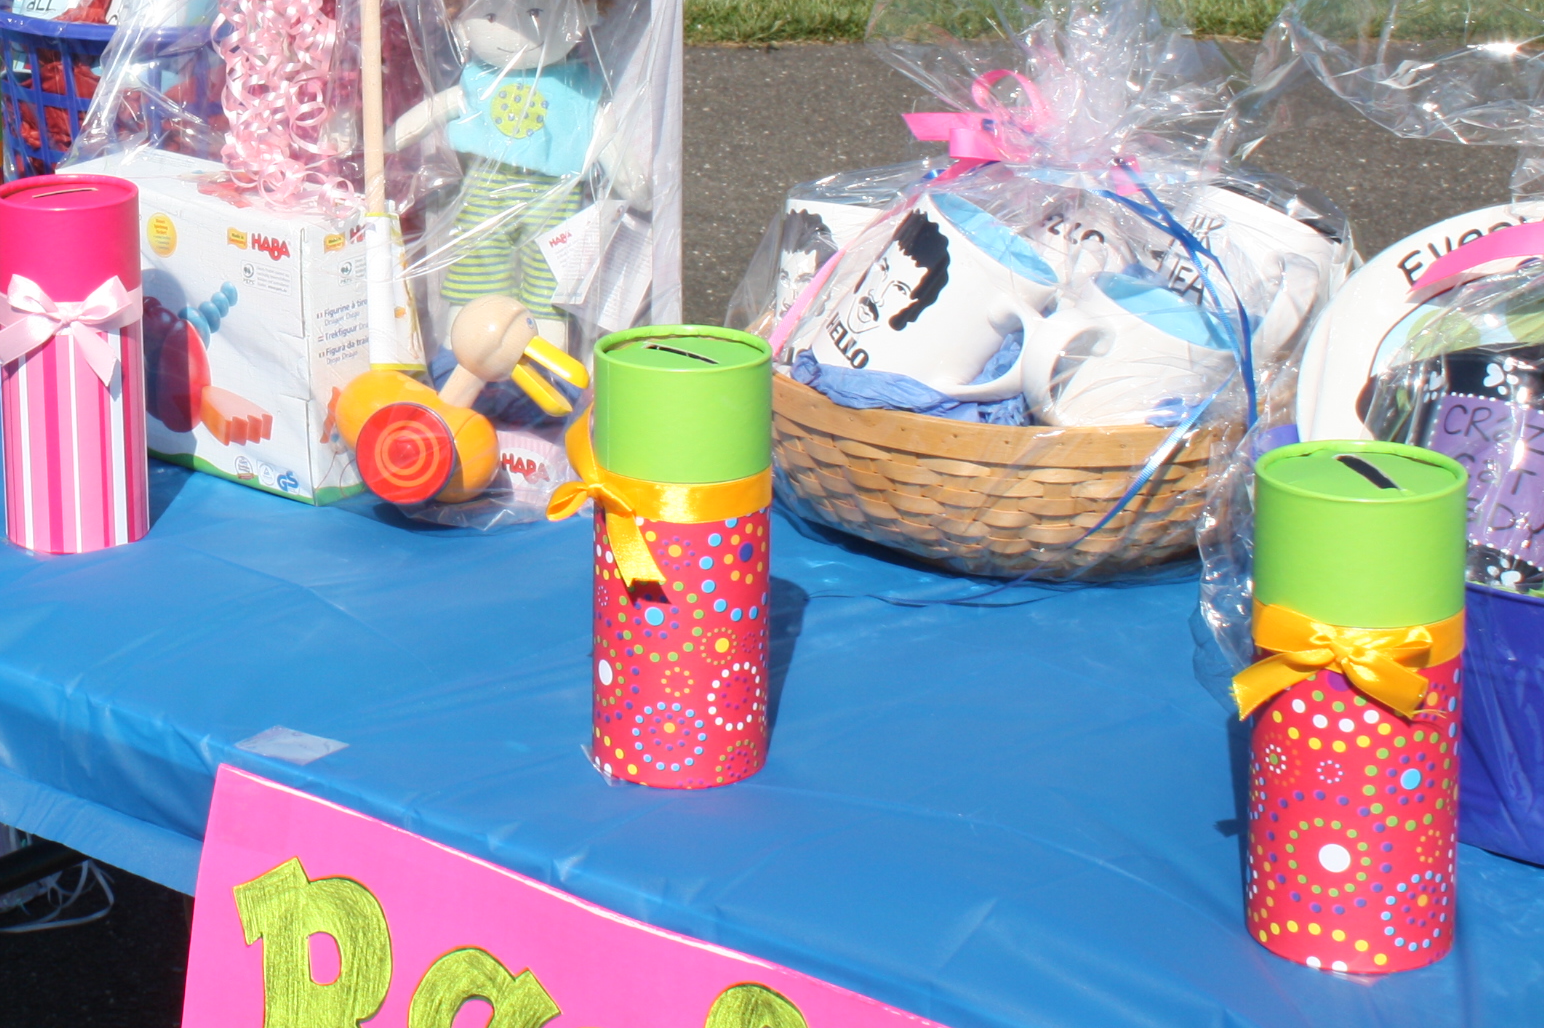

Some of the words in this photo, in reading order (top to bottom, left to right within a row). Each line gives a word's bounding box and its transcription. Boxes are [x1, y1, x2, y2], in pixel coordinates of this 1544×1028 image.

[251, 233, 291, 261] HABA
[826, 311, 869, 370] HELLO
[502, 452, 551, 485] HABA
